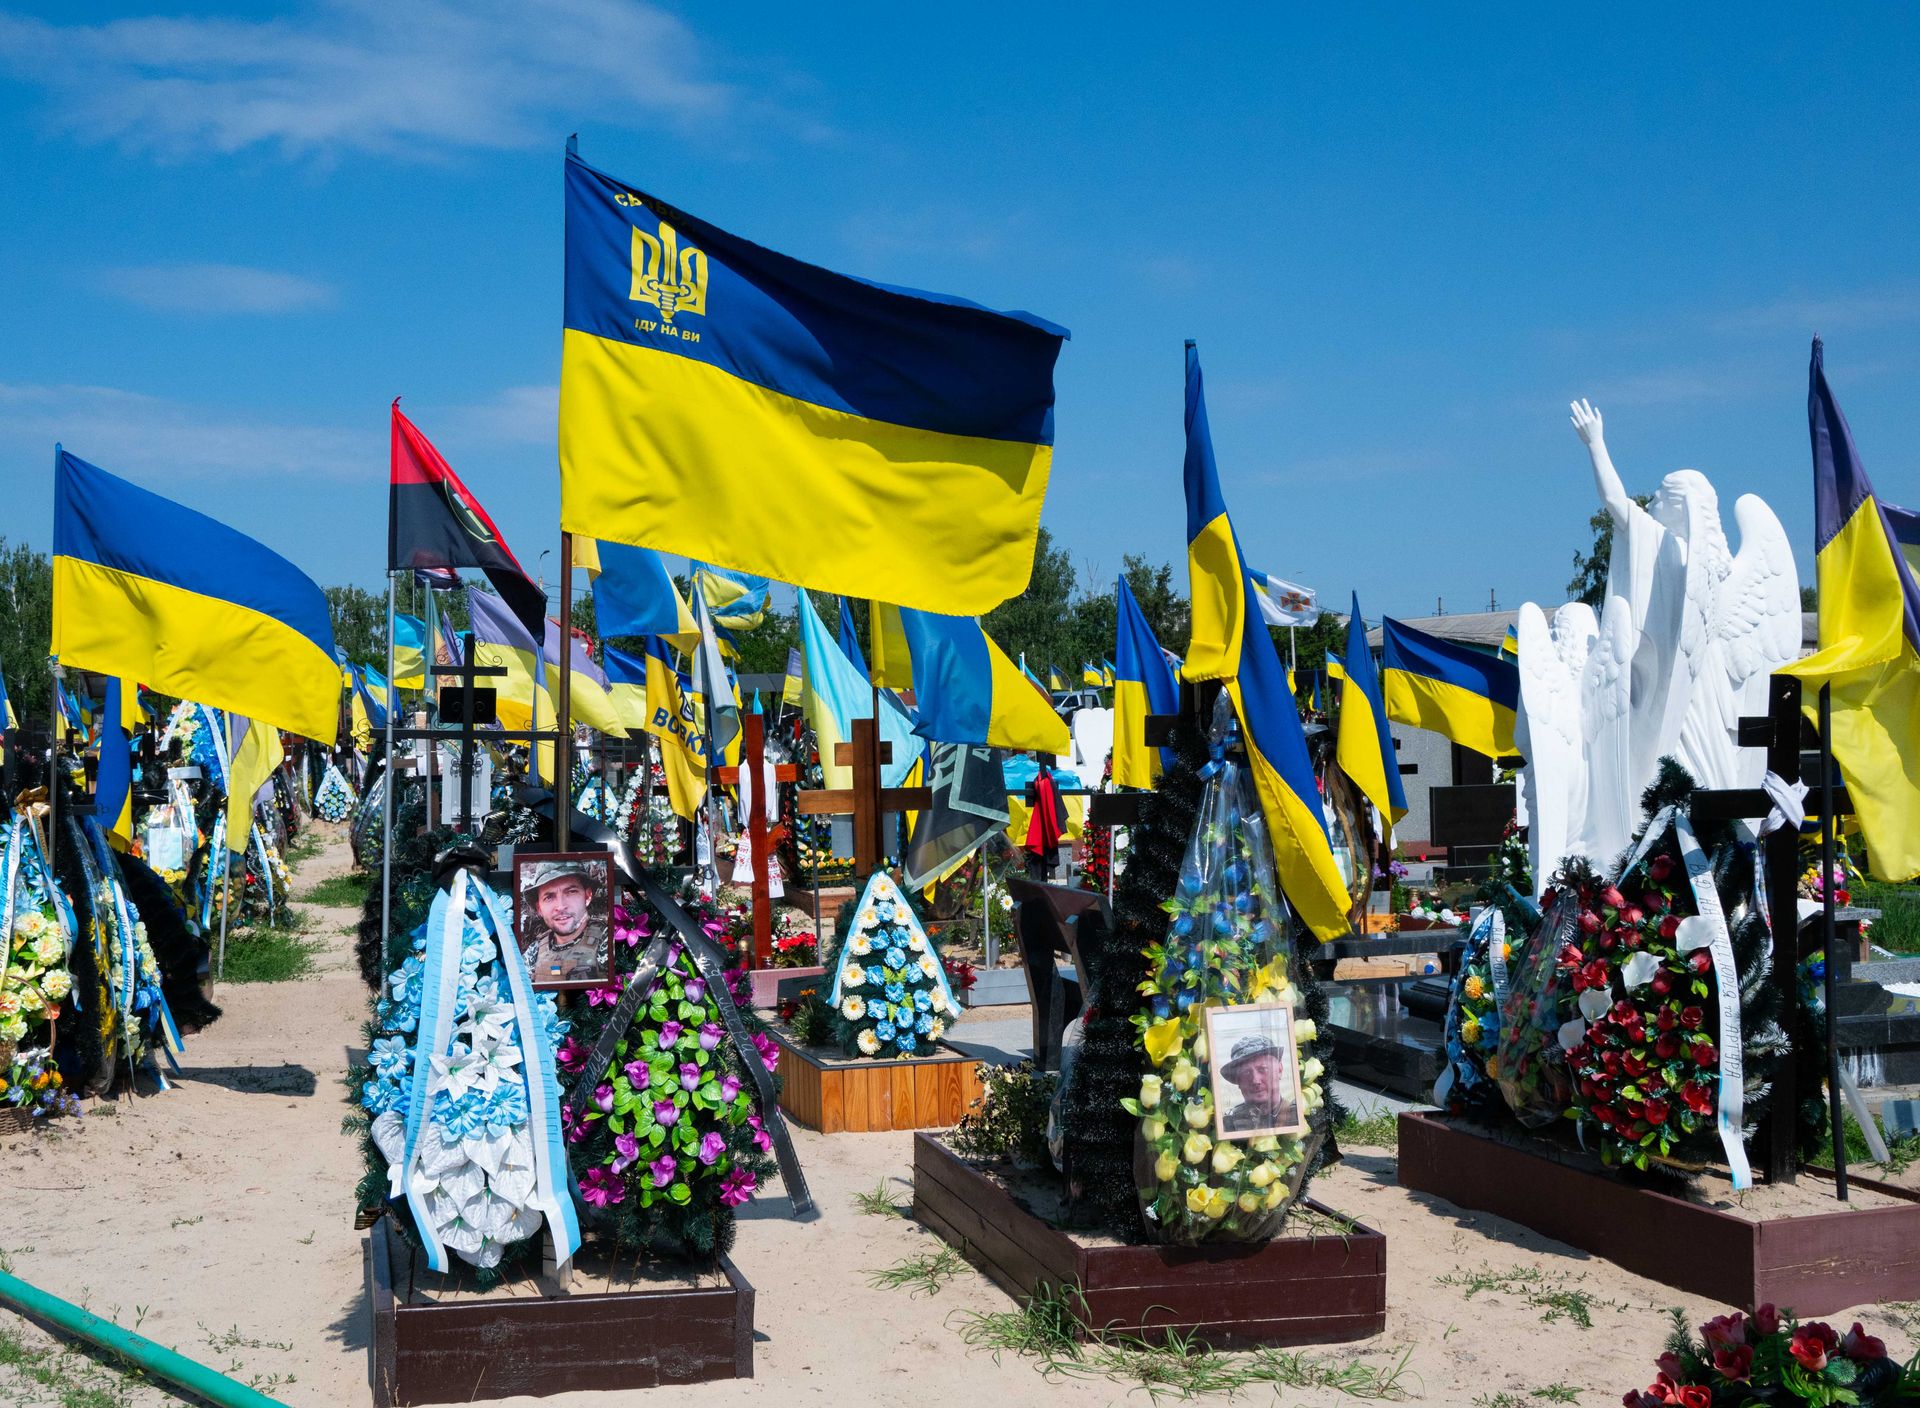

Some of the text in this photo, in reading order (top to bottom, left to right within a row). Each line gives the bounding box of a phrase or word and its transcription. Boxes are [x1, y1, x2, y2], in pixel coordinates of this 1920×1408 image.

[634, 318, 701, 343] ІДУ НА ВИ
